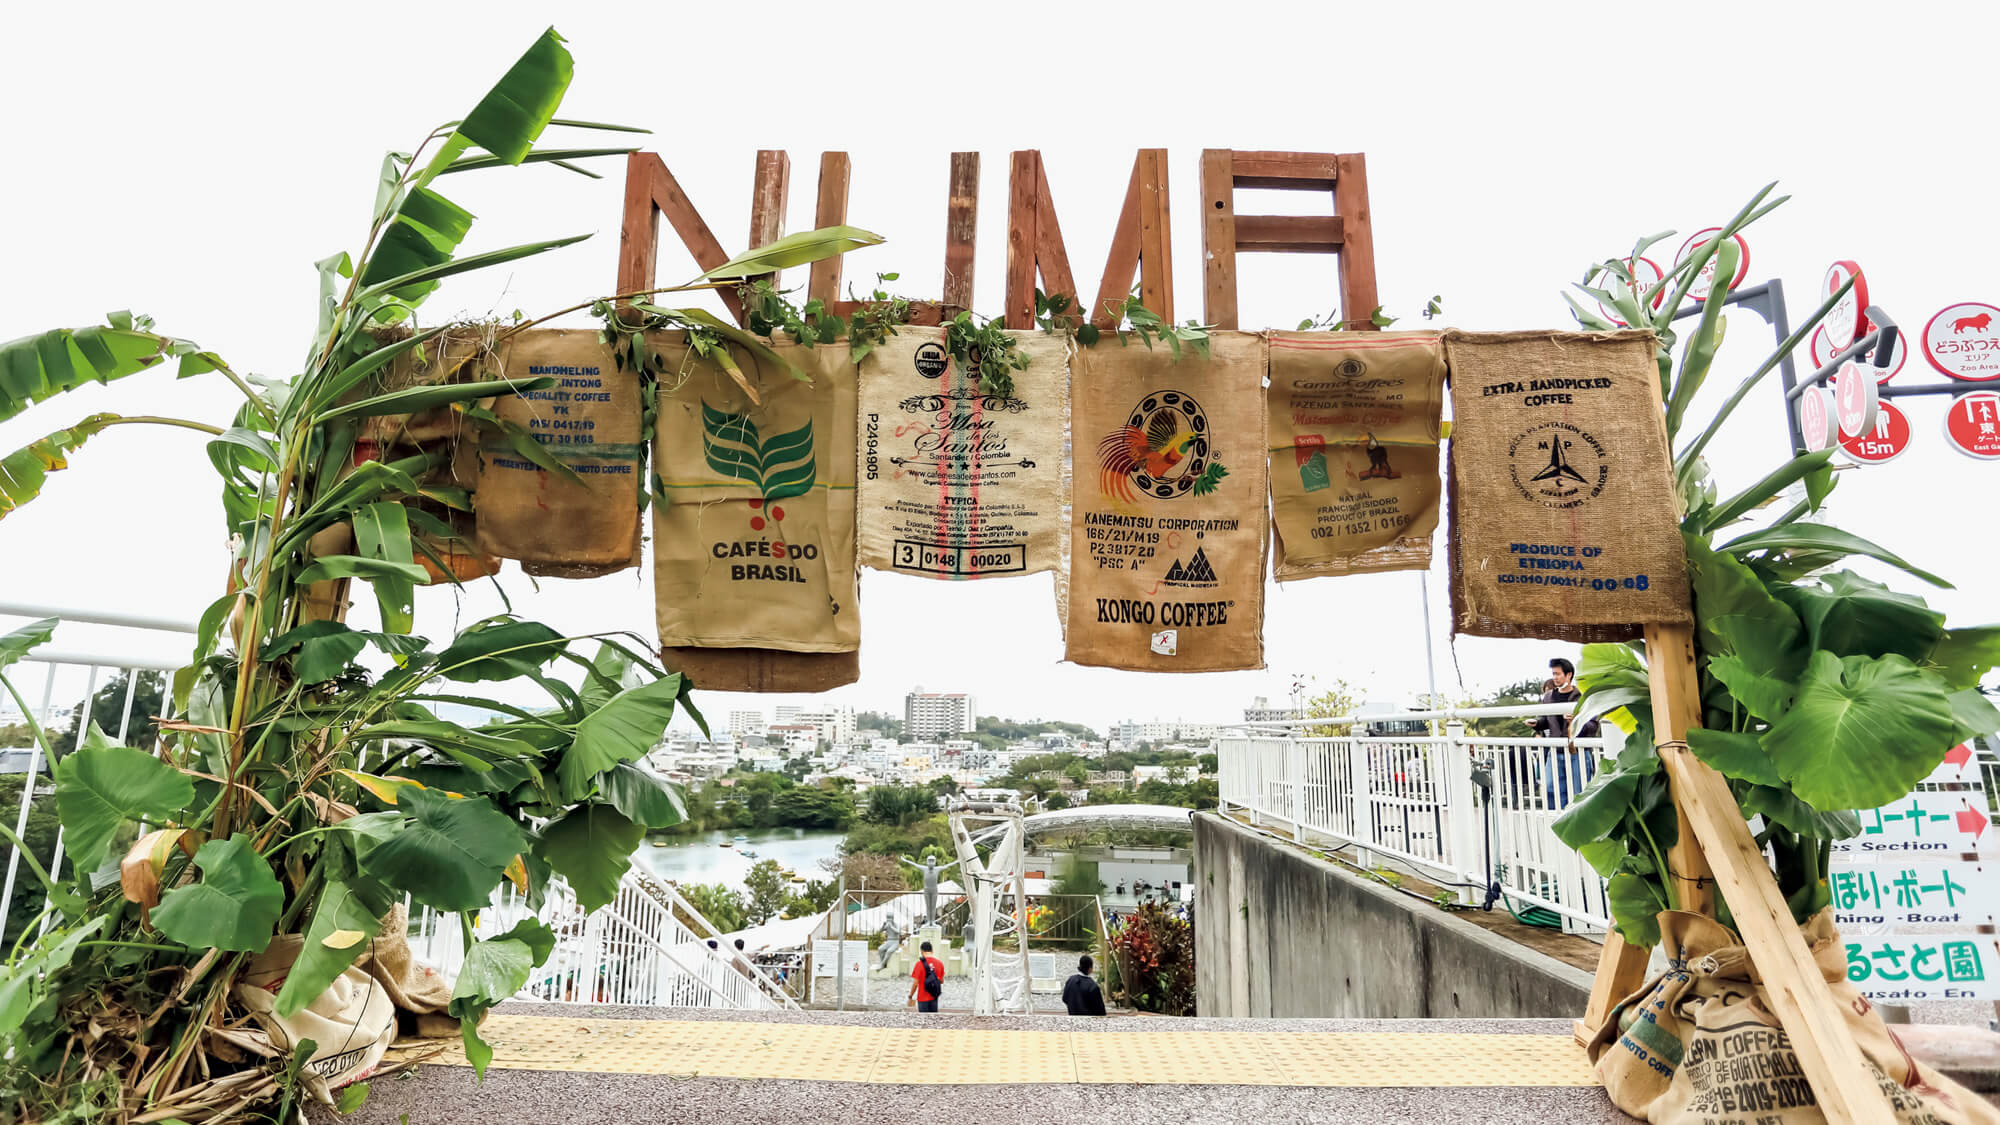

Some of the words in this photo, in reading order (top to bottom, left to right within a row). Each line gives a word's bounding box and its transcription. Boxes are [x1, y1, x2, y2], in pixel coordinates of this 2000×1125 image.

[1965, 353, 1991, 362] エリア
[529, 366, 600, 376] MANDHELING
[559, 379, 602, 388] INTONG
[1483, 382, 1525, 396] EXTRA
[1530, 377, 1613, 391] HANDPICKED
[574, 392, 611, 402] COFFEE
[1524, 393, 1574, 407] COFFEE
[867, 413, 879, 480] P2494905
[914, 432, 1007, 452] Santos
[1537, 440, 1549, 450] M
[1563, 440, 1573, 450] P
[1581, 432, 1606, 459] COFFEE
[1858, 442, 1894, 455] 15m
[929, 453, 968, 461] Santander
[975, 452, 1011, 460] Colombia
[602, 465, 632, 474] COFFEE
[943, 496, 978, 505] TYPICA
[1369, 507, 1400, 518] BRAZIL
[1084, 512, 1153, 528] KANEMATSU
[1158, 518, 1239, 531] CORPORATION
[1086, 527, 1160, 544] 166/21/M19
[1311, 526, 1334, 540] 002
[1345, 522, 1372, 536] 1352
[787, 544, 818, 560] DO
[902, 546, 914, 563] 3
[1511, 543, 1577, 557] PRODUCE
[1581, 546, 1602, 558] OF
[924, 551, 955, 566] 0148
[970, 554, 1011, 567] 00020
[1519, 557, 1585, 571] ETHIOPIA
[731, 564, 806, 583] BRASIL
[1096, 598, 1155, 625] KONGO
[1861, 841, 1949, 852] Section
[1830, 868, 1967, 910] ぼり・ボート
[1722, 1030, 1793, 1059] COFFEE
[1730, 1052, 1808, 1082] GUATEMALA
